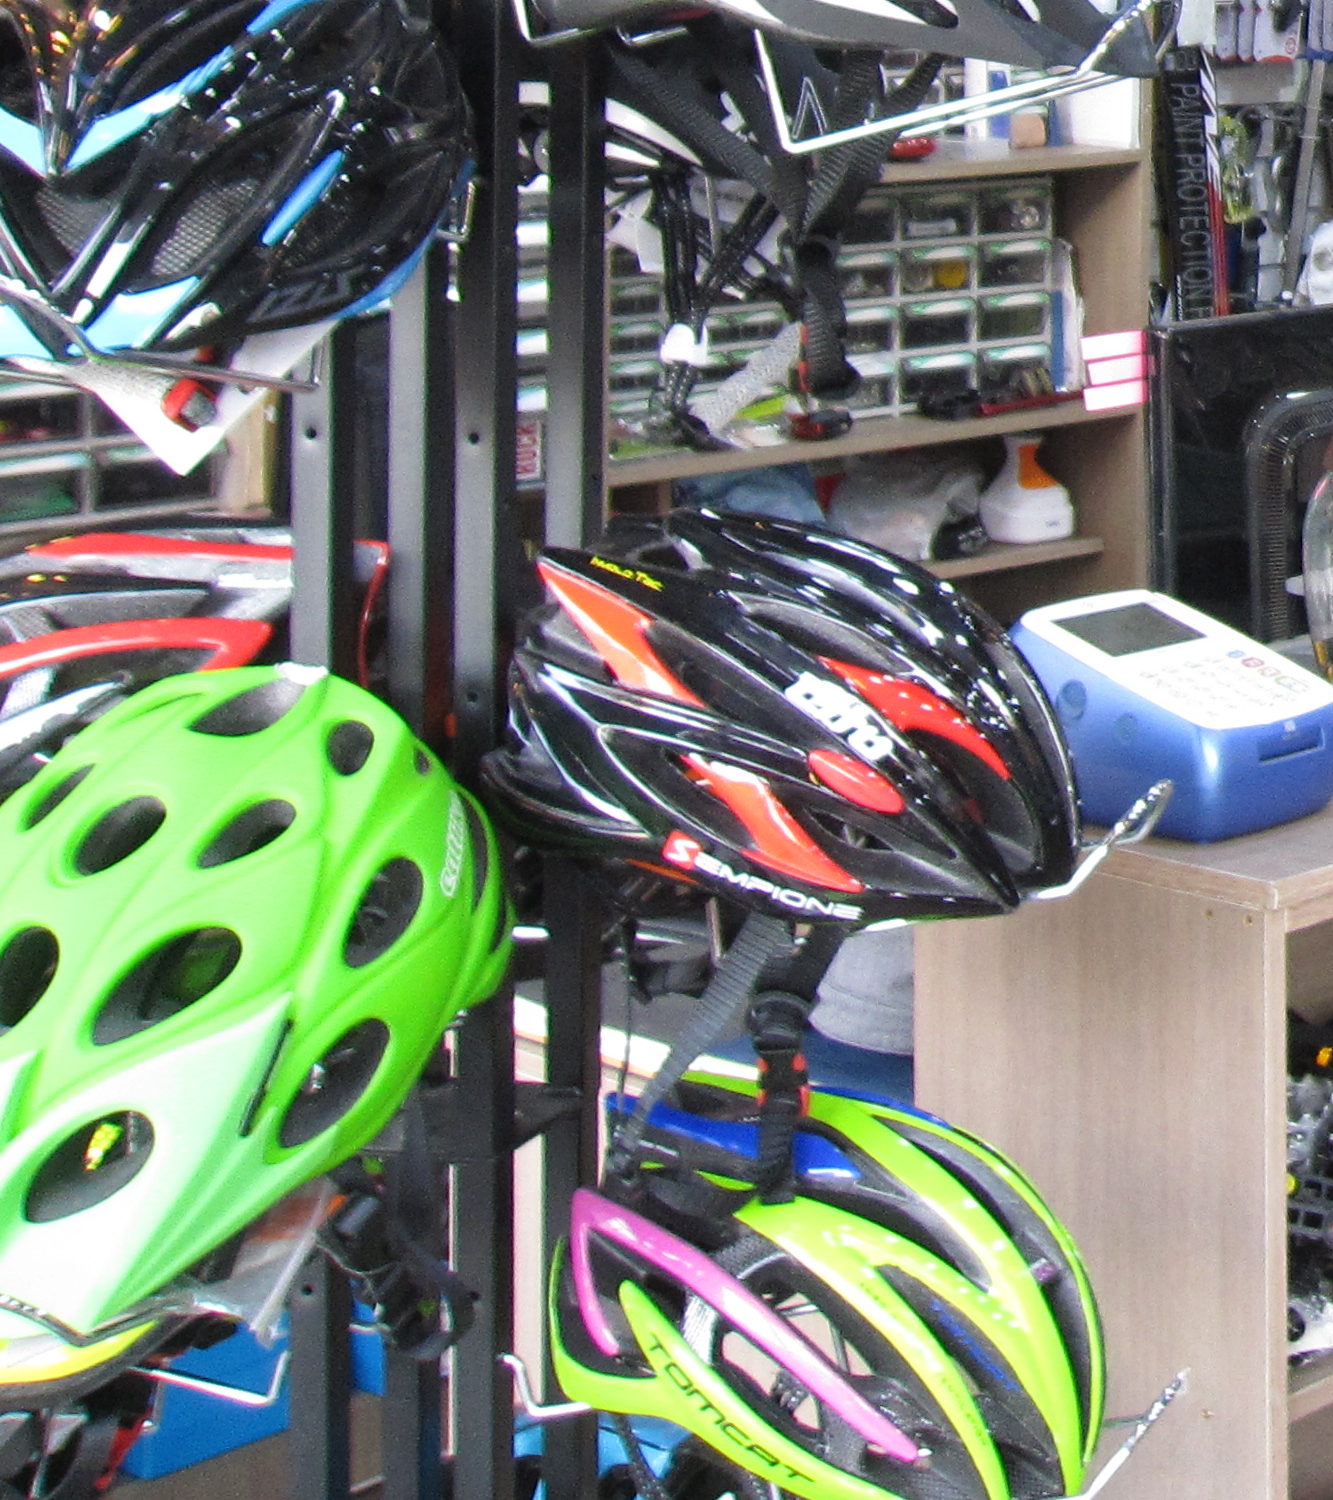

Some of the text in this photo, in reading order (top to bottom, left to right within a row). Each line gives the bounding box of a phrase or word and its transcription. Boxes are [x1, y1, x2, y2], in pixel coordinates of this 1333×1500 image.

[1169, 82, 1203, 147] PAINT
[1176, 153, 1214, 299] PROTECTION
[661, 829, 863, 921] SEMPIONE
[649, 1331, 815, 1485] TOMCAT
